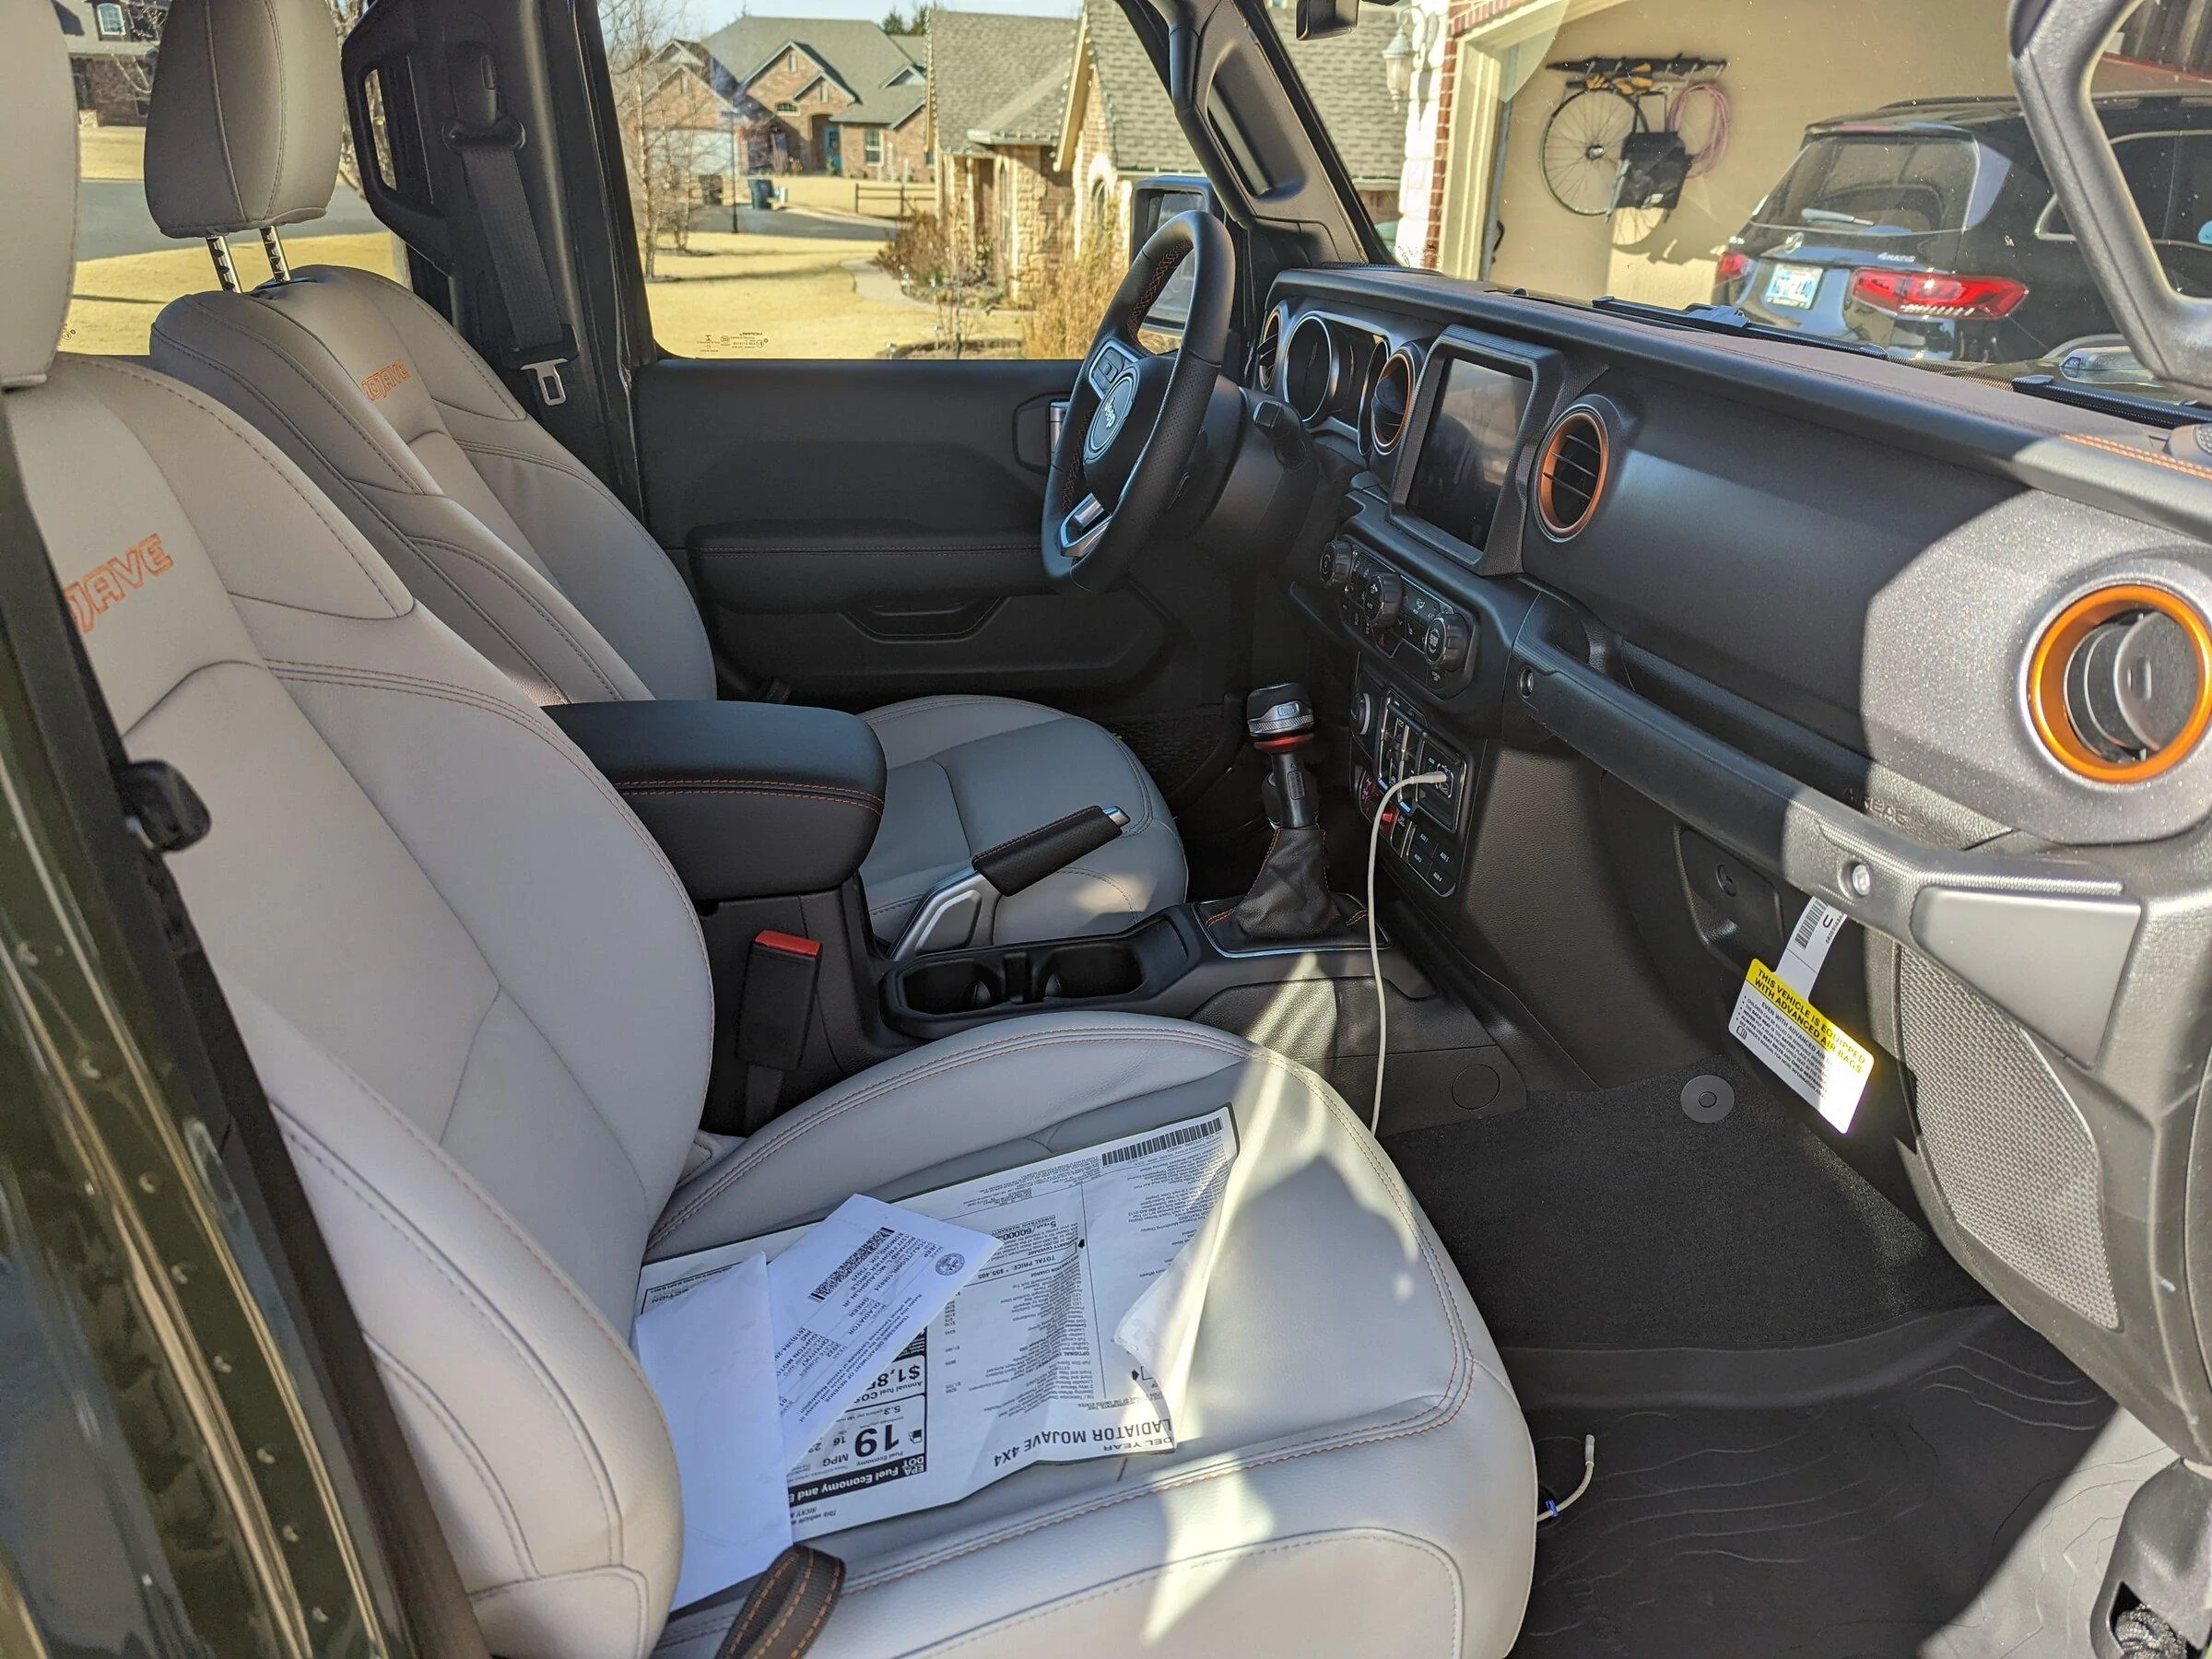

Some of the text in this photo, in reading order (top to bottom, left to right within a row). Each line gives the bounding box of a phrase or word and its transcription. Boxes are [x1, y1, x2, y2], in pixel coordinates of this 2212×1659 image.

[64, 533, 174, 634] JAVE
[1753, 976, 1861, 1074] WITH ADVANCED AIR BAGS
[1757, 968, 1865, 1065] THIS VEHICLE IS EQUIPPED
[1761, 1001, 1825, 1060] EVEN WITH ADVANCED AIR
[889, 1237, 915, 1259] RICHARD
[922, 1244, 937, 1256] JEEP
[1028, 1245, 1052, 1255] COVERAGE
[868, 1246, 898, 1271] FRONTIER
[1035, 1254, 1054, 1264] TOTAL
[849, 1272, 871, 1290] CIRCLE
[850, 1265, 886, 1299] MCLAUGHLIN
[848, 1297, 870, 1316] GREEN
[847, 1302, 881, 1335] GLADIATOR
[882, 1315, 909, 1340] TENNESSEE
[799, 1330, 812, 1340] INC
[792, 1334, 818, 1358] GUPTON
[825, 1343, 841, 1356] 2022
[853, 1341, 884, 1371] DEPARTMENT
[824, 1380, 847, 1401] REVENUE
[880, 1387, 892, 1396] fuel
[897, 1380, 922, 1392] Annual
[885, 1404, 900, 1416] 5.3
[855, 1423, 900, 1458] 19
[994, 1417, 1172, 1466] LADIATOR MOJAVE 4X4
[1102, 1441, 1142, 1453] YEAR
[823, 1451, 848, 1467] MPG
[902, 1454, 924, 1466] DOT
[876, 1465, 898, 1480] Fuel
[905, 1464, 923, 1475] EPA
[822, 1470, 871, 1495] Economy
[797, 1486, 818, 1500] and
